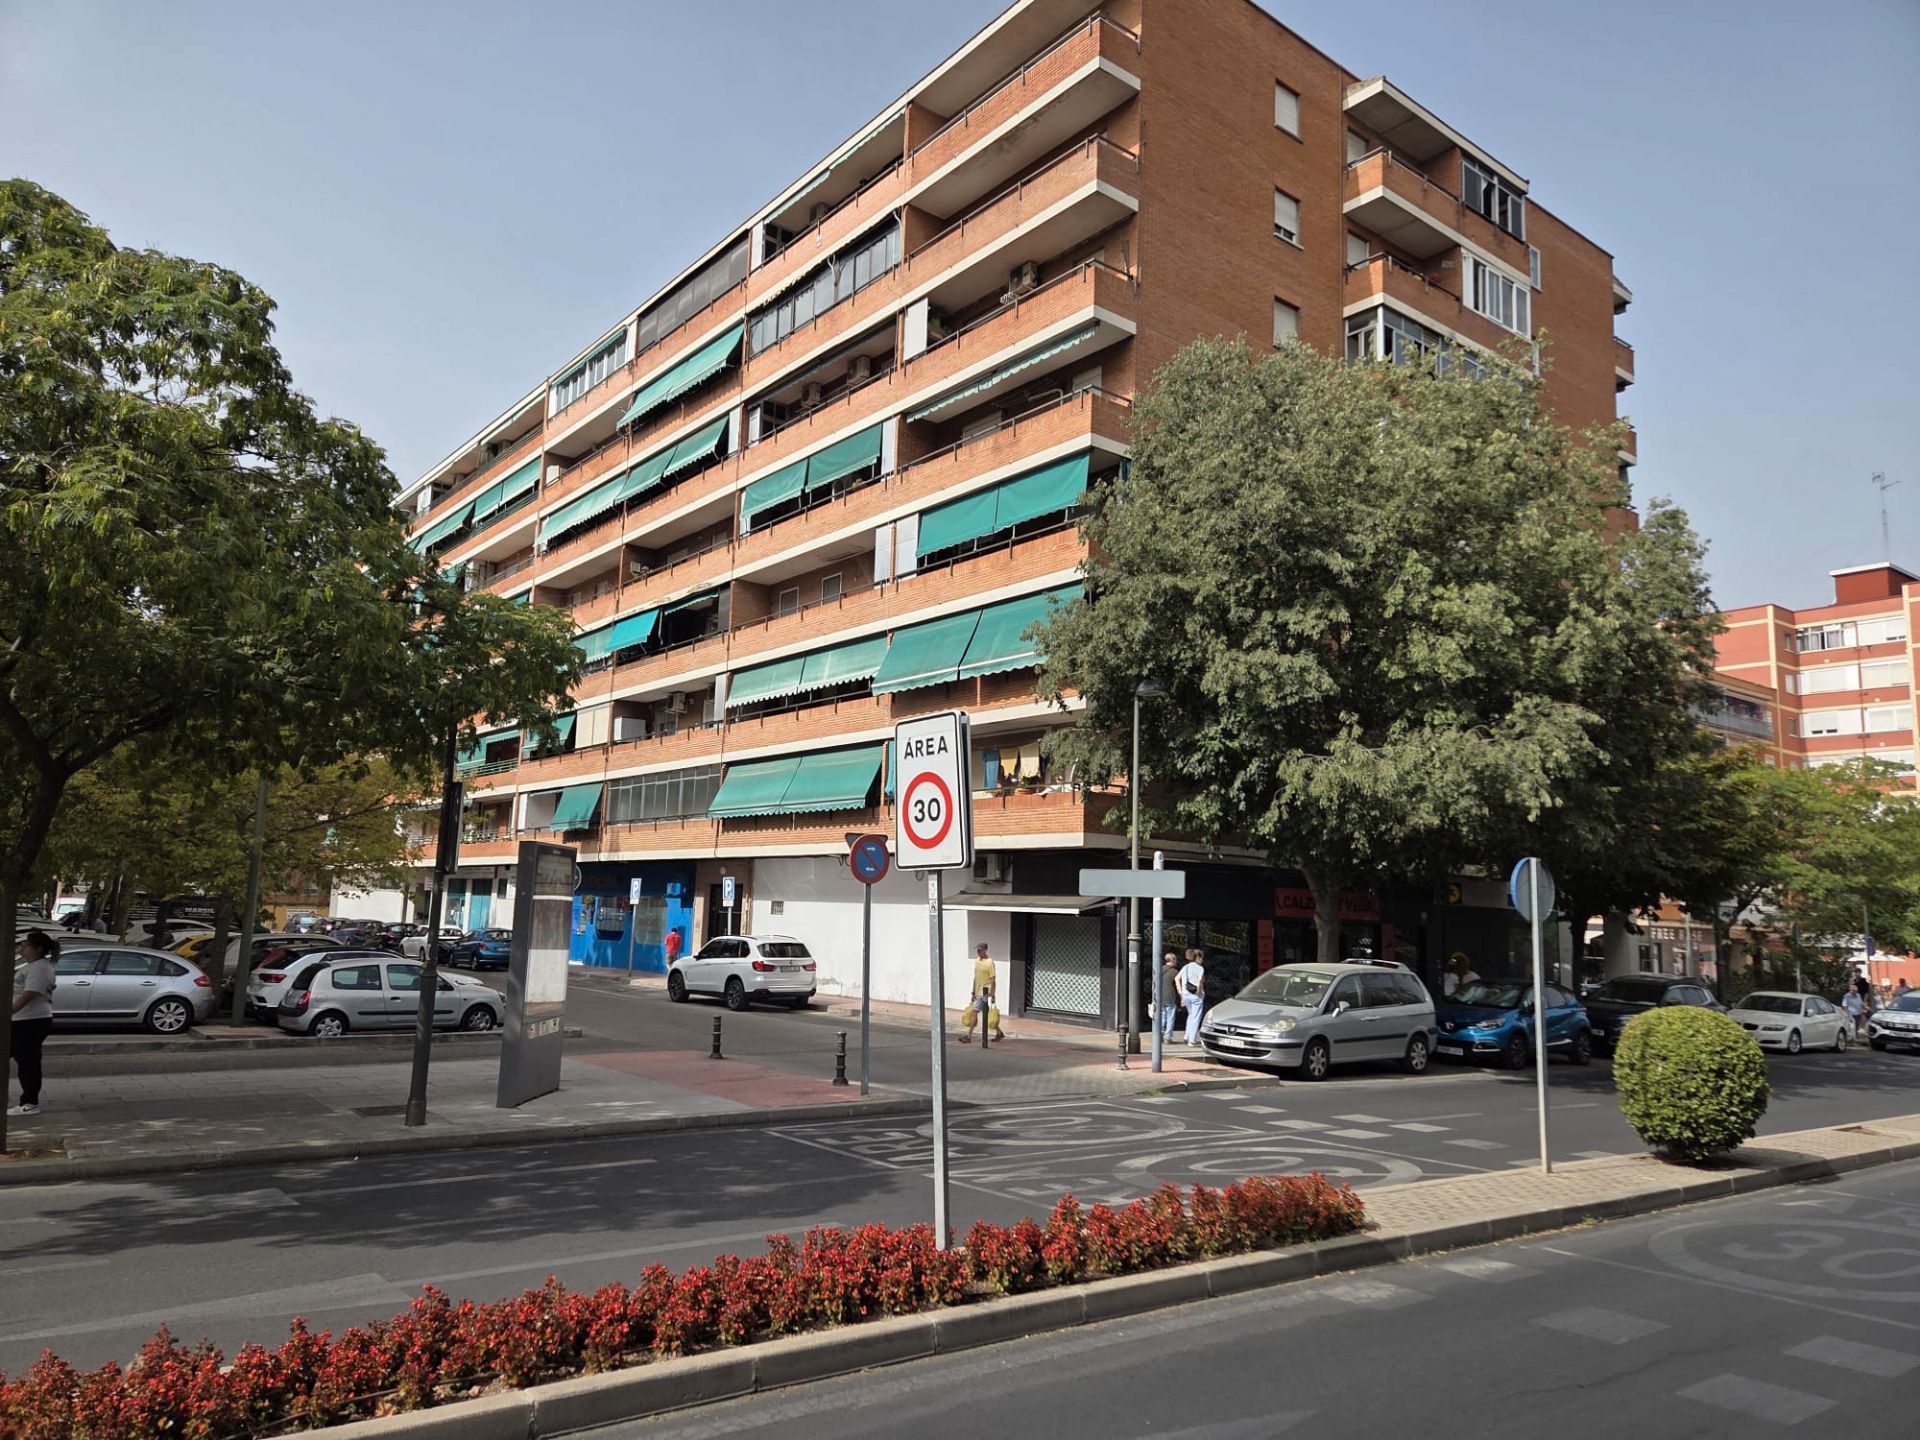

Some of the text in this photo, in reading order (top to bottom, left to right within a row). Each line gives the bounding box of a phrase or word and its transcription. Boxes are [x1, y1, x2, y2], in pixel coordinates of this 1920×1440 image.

[904, 735, 948, 759] ÁREA
[914, 797, 941, 823] 30
[1650, 927, 1703, 942] FREE BSE
